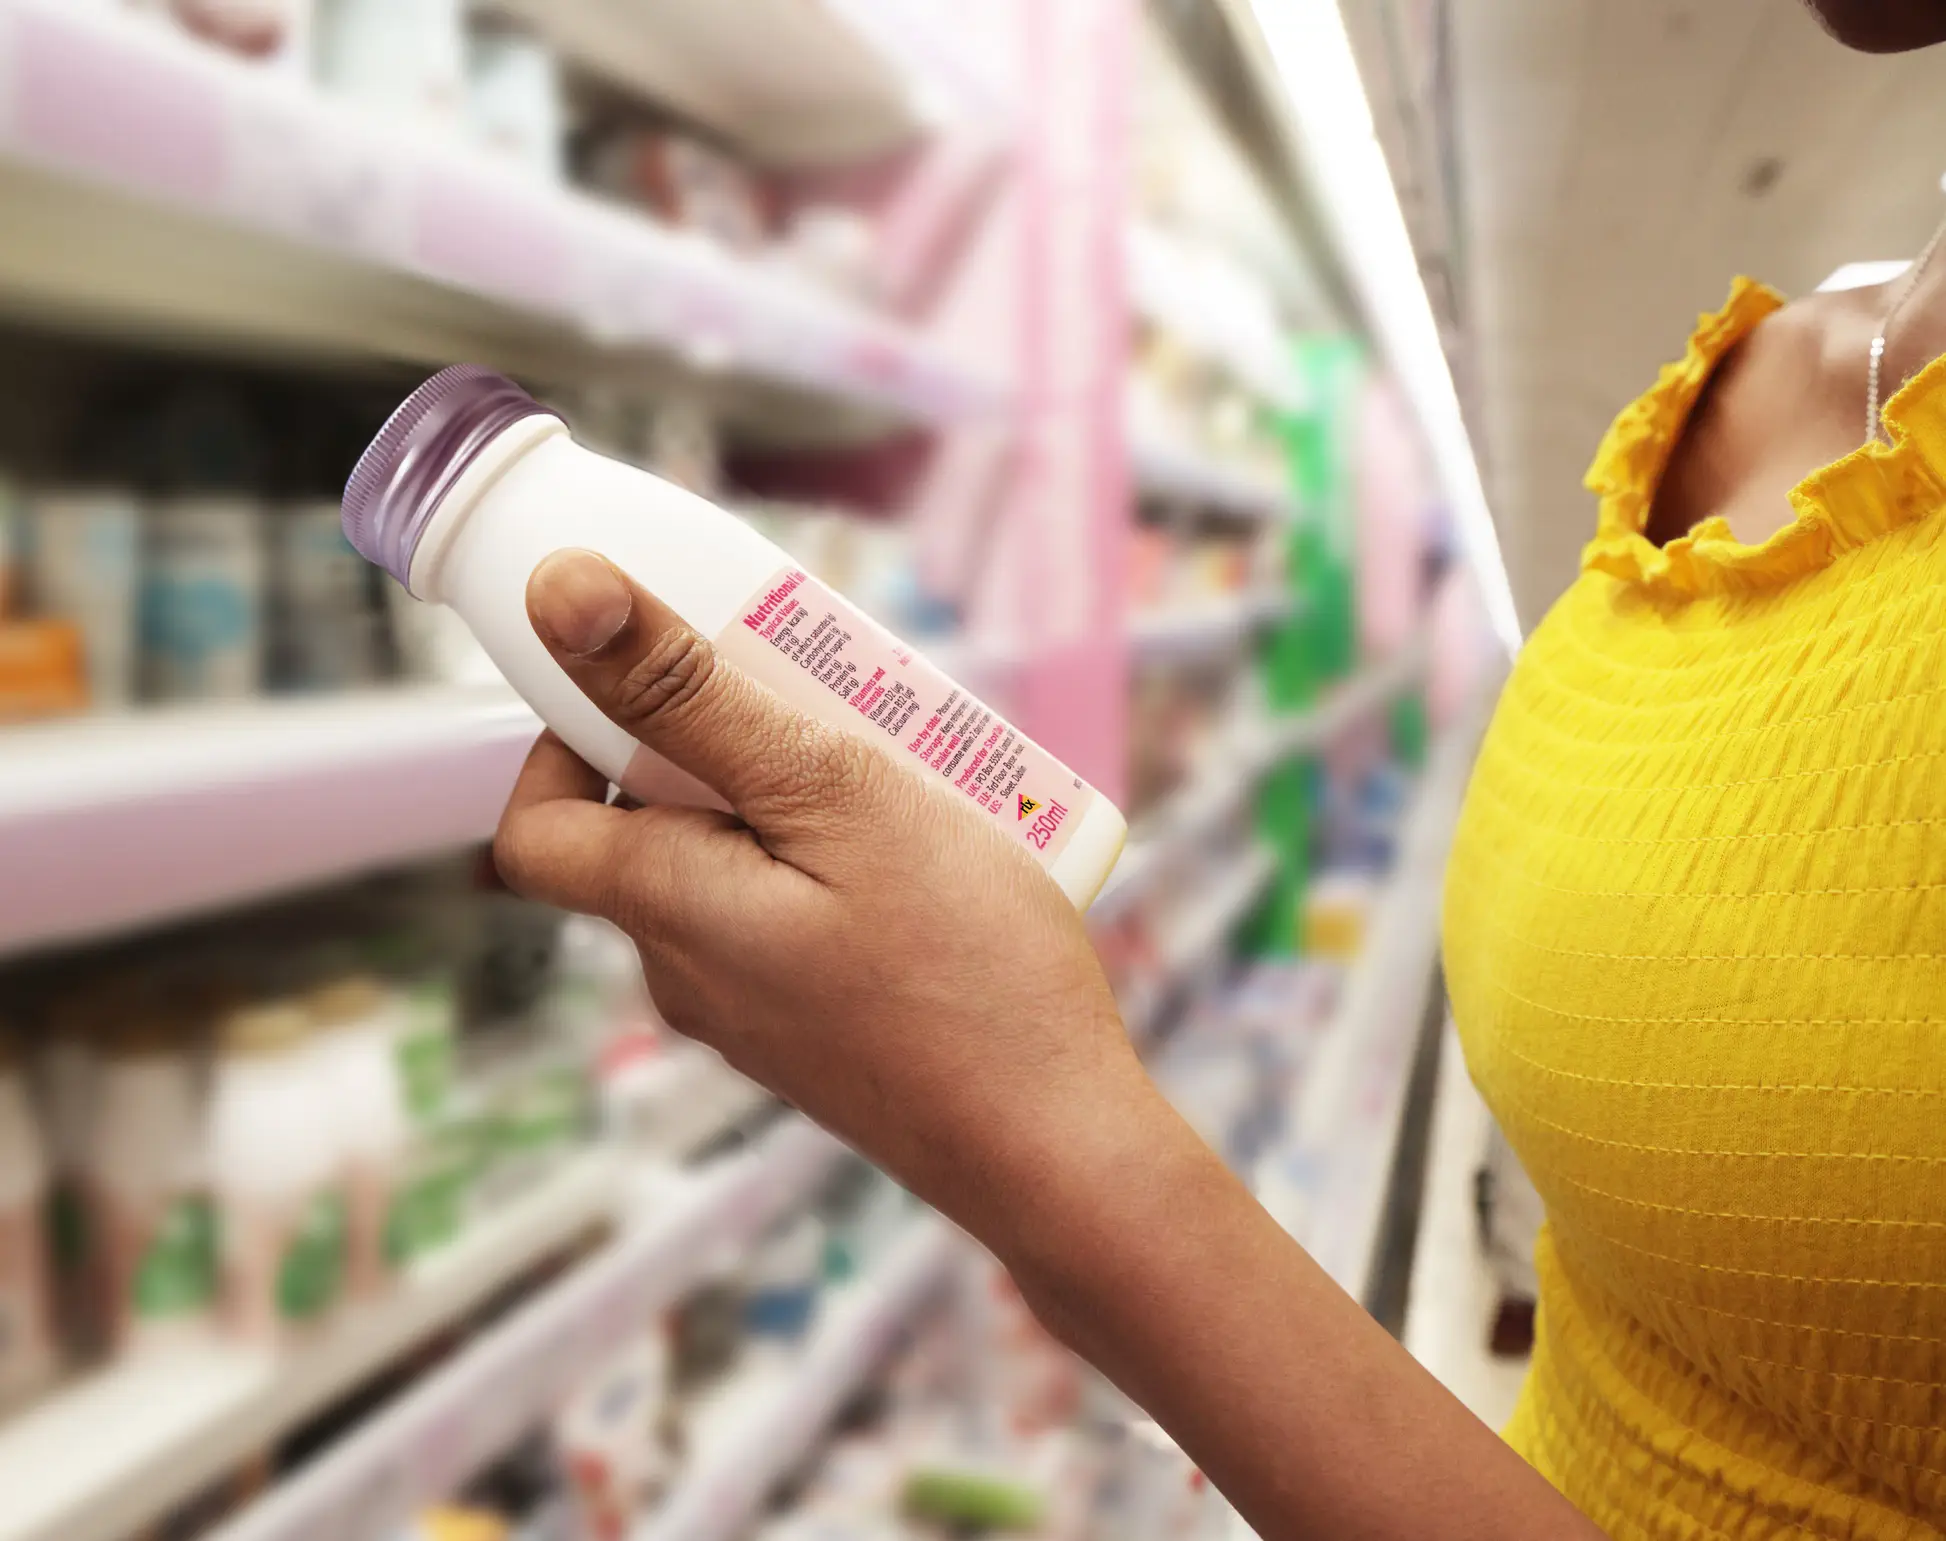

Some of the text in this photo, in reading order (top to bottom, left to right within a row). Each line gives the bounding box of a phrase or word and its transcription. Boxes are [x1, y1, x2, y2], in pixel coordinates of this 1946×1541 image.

[743, 576, 799, 631] Nutritional
[758, 598, 800, 639] Typical Values
[769, 625, 793, 649] Energy,
[786, 613, 802, 628] kcal
[779, 632, 800, 655] Fat (g)
[791, 650, 801, 662] of
[796, 637, 814, 656] which
[810, 618, 832, 640] saturates
[799, 632, 835, 669] Carbohydrates
[810, 665, 820, 677] of
[815, 652, 834, 670] which
[829, 637, 846, 655] sugars
[818, 659, 843, 685] Fibre (g)
[827, 661, 857, 692] Protein (g)
[837, 676, 860, 700] Salt (g)
[848, 666, 886, 708] Vitamins and
[857, 685, 886, 715] Minerals
[867, 698, 891, 722] Vitamin
[884, 689, 897, 702] D2
[877, 706, 900, 729] Vitamin
[893, 695, 908, 709] B12
[887, 699, 920, 737] Calcium (mg)
[907, 737, 924, 753] Use
[917, 728, 932, 741] by
[925, 714, 942, 732] date:
[919, 732, 946, 763] Storage:
[939, 720, 955, 736] Keep
[930, 747, 952, 771] Shake
[946, 733, 962, 751] well
[955, 721, 972, 738] before
[942, 750, 965, 778] consume
[960, 735, 975, 753] within
[954, 754, 983, 789] Produced
[976, 747, 989, 760] for
[965, 782, 981, 797] UK:
[974, 772, 988, 785] PO
[981, 763, 995, 776] Box
[976, 791, 992, 807] EU:
[985, 779, 999, 794] 3rd
[992, 768, 1008, 784] Floor
[987, 799, 1003, 815] US:
[1026, 798, 1068, 850] 250ml
